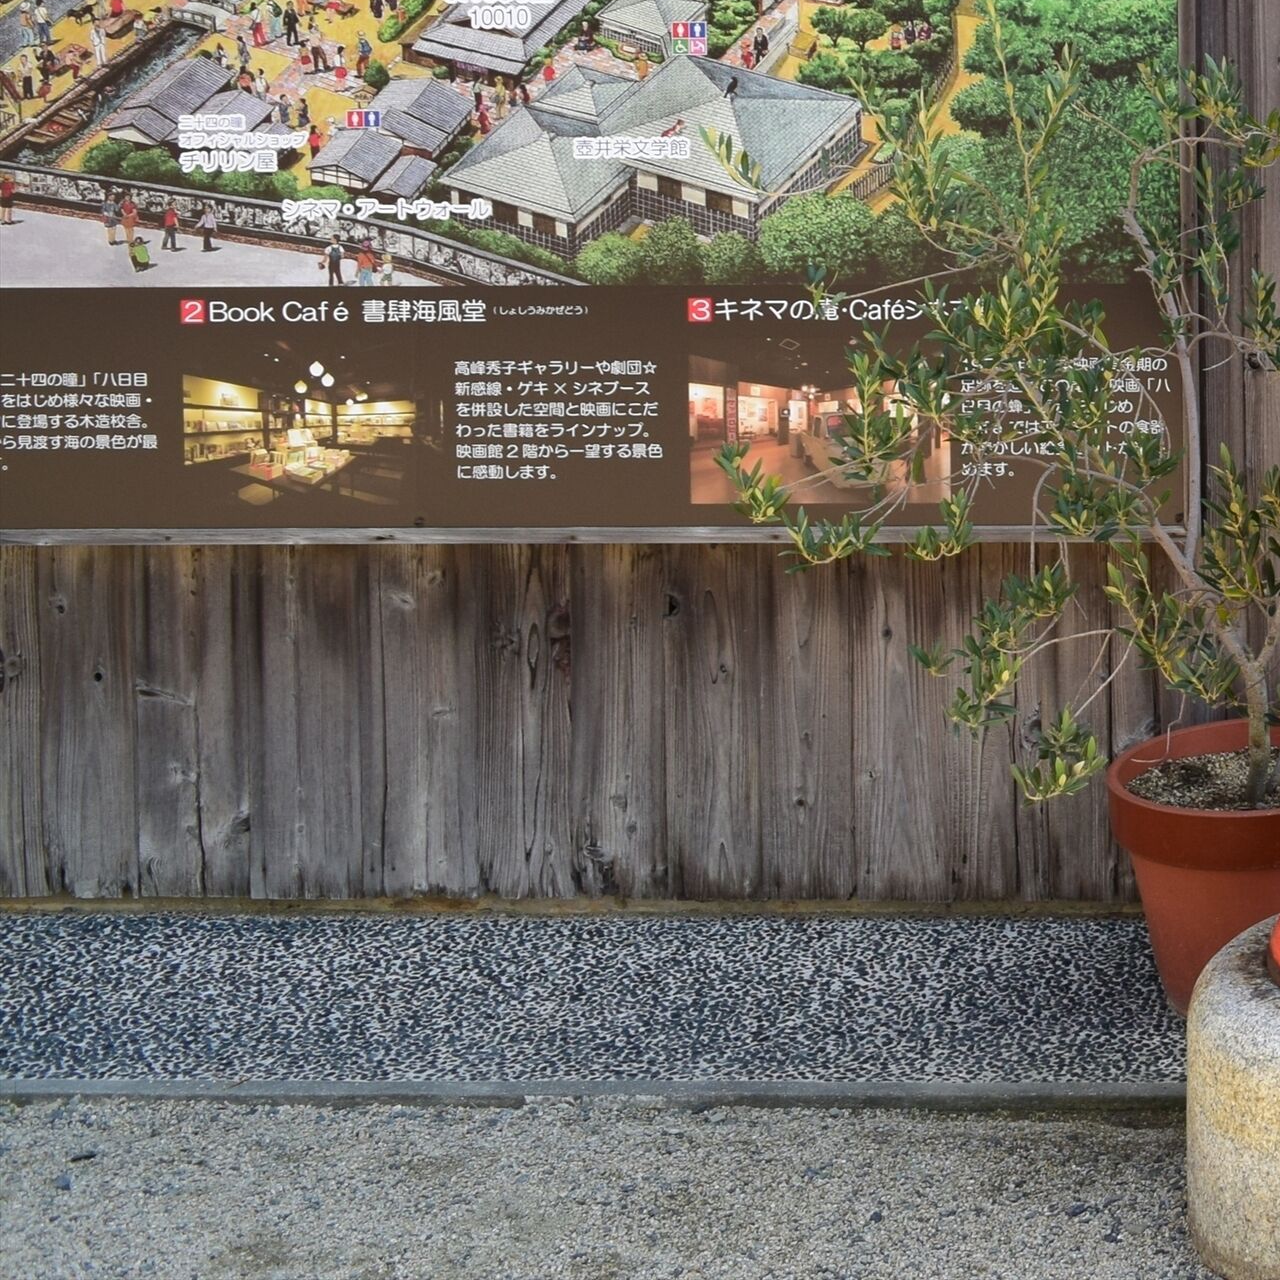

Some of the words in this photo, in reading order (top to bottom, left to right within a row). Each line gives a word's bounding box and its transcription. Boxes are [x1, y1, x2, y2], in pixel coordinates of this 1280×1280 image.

[470, 8, 529, 26] 10010
[180, 132, 307, 146] オフィシャルショップ
[576, 139, 688, 156] 壺井栄文学館
[182, 151, 276, 170] チリリン屋
[284, 200, 490, 218] シネマ・アートウォール
[208, 300, 275, 322] Book
[455, 401, 658, 418] を併設した空間と映画にこだ
[456, 422, 650, 438] わった書籍をラインナップ。
[457, 464, 557, 480] に感動します。
